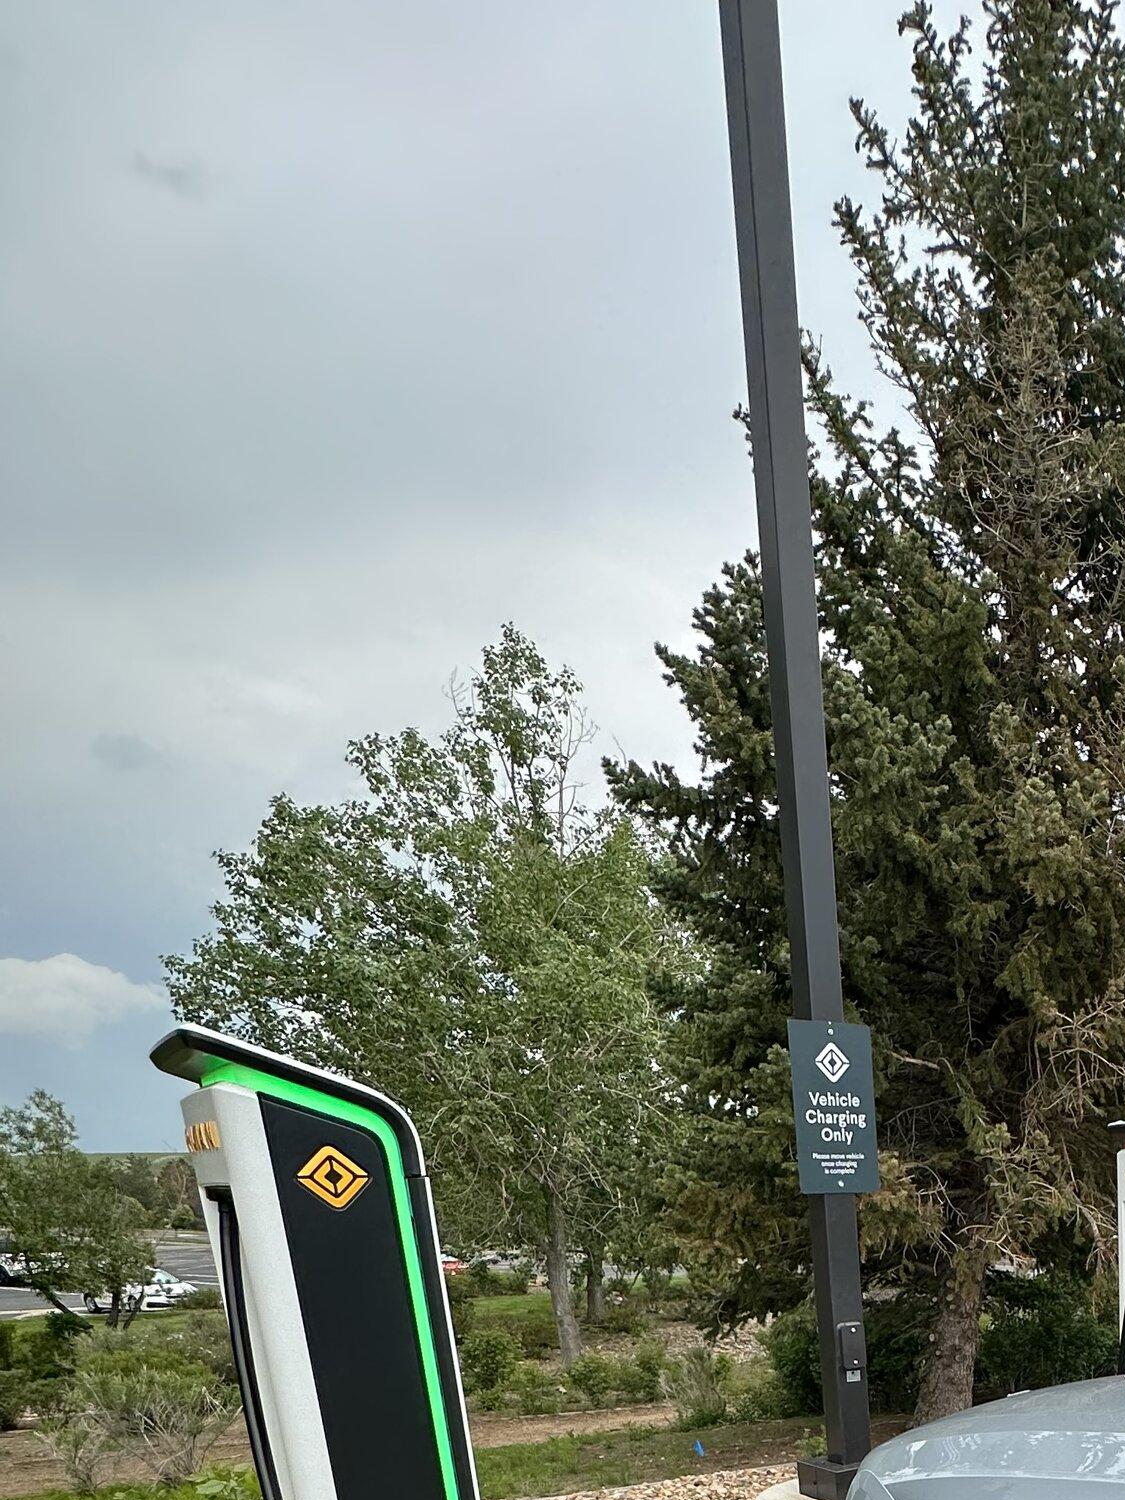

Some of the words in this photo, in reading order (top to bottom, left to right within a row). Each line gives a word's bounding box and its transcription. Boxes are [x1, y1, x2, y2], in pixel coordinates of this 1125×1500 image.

[808, 1091, 861, 1107] Vehicle
[805, 1110, 866, 1129] Charging
[821, 1127, 854, 1145] Only
